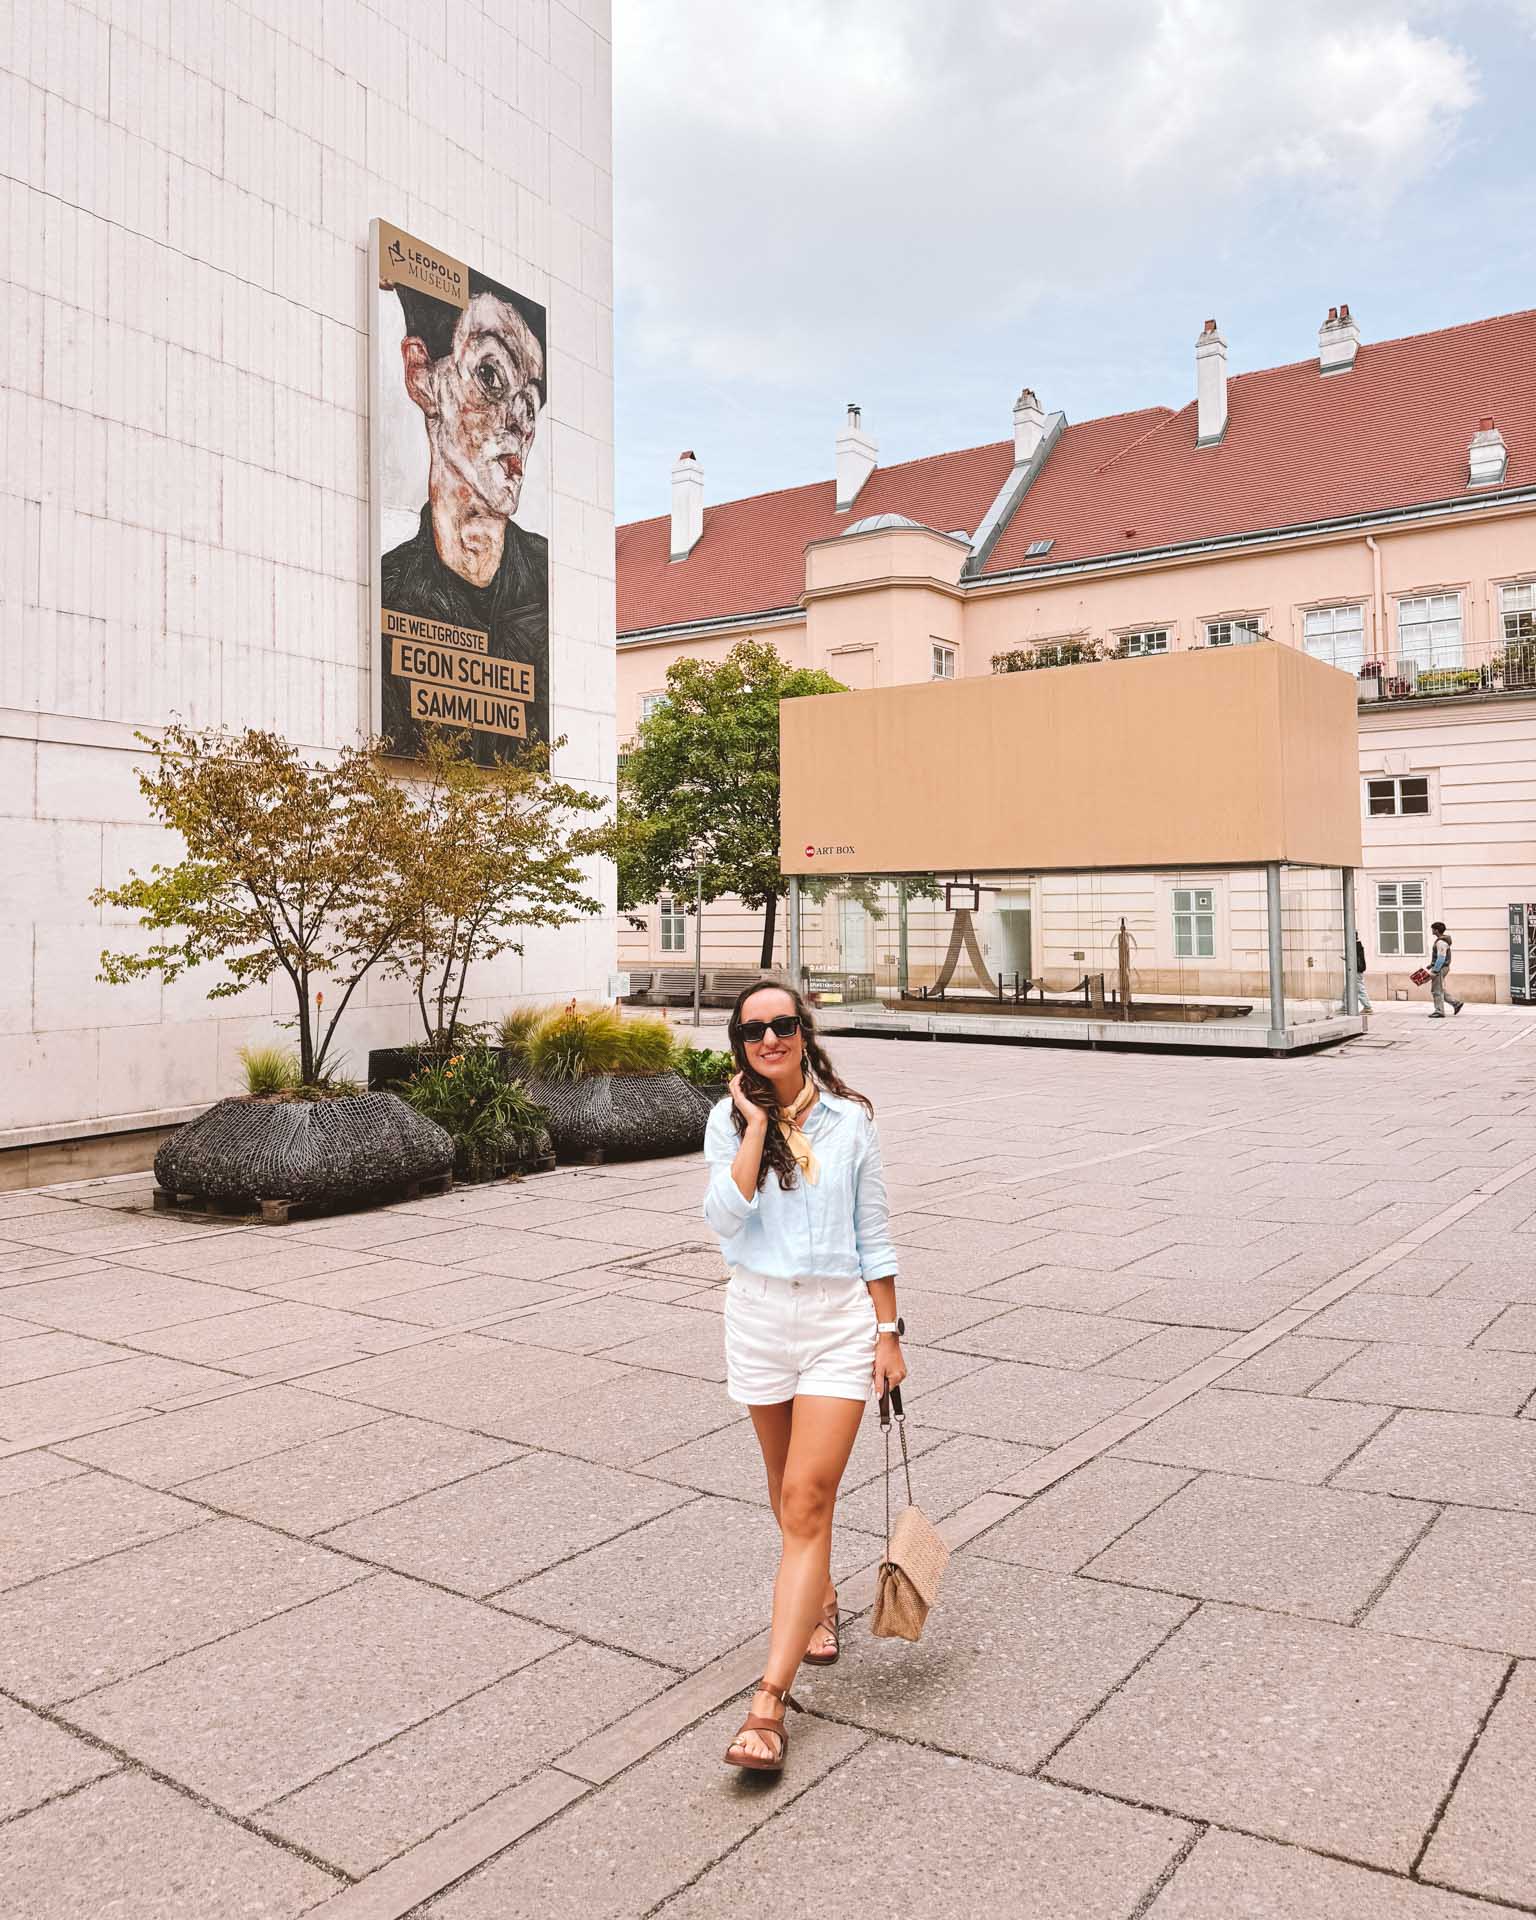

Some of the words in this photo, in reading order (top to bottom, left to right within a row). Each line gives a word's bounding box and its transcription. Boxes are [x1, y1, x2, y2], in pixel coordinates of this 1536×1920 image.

[408, 248, 461, 284] LEOPOLD
[408, 262, 461, 299] MUSEUM
[387, 614, 407, 633] DIE
[408, 618, 485, 651] WELTGRÖSSTE
[400, 644, 453, 681] EGON
[458, 657, 530, 695] SCHIELE
[416, 688, 520, 731] SAMMLUNG
[816, 846, 835, 855] ART
[836, 846, 855, 854] BOX
